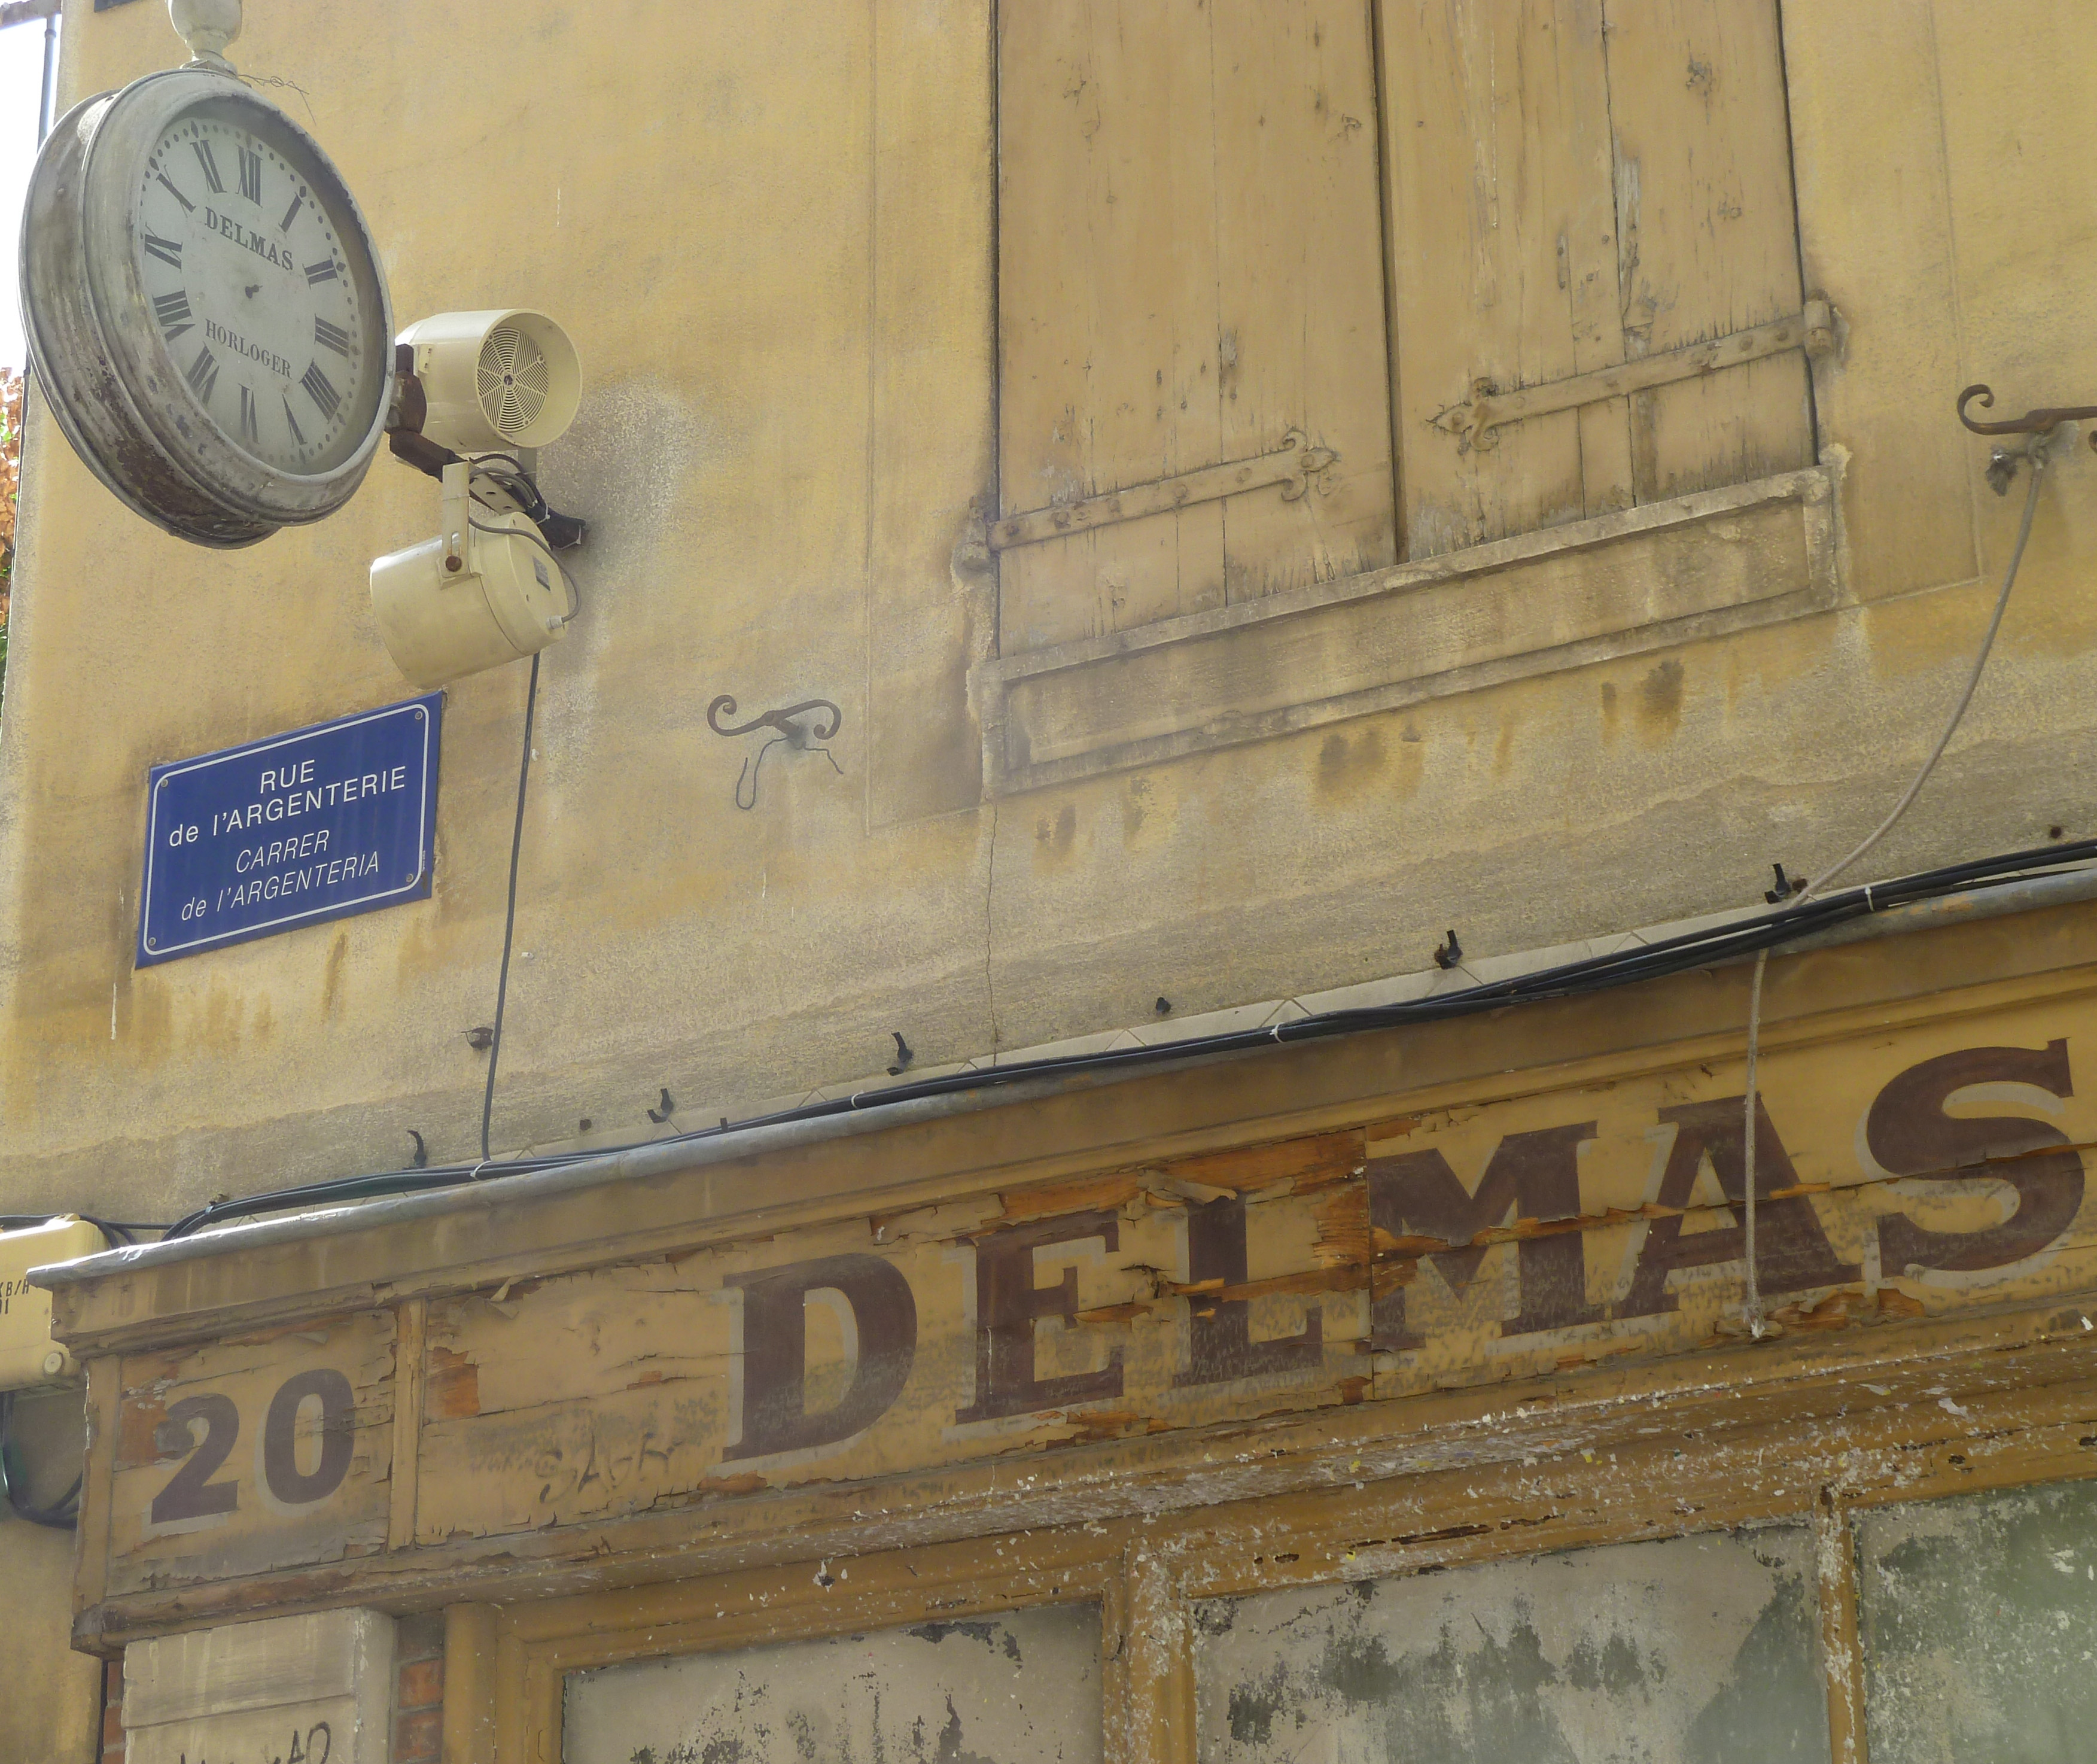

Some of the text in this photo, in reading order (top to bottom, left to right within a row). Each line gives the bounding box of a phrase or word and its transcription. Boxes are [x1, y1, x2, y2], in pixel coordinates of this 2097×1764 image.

[190, 139, 227, 193] XI
[236, 144, 263, 208] XII
[204, 206, 294, 271] DELMAS
[279, 191, 303, 233] I
[303, 256, 339, 291] II
[152, 287, 196, 342] VIII
[314, 314, 349, 358] III
[204, 318, 293, 380] HORLOGER
[282, 392, 308, 447] V
[299, 358, 343, 424] IIII
[260, 759, 316, 794] RUE
[169, 765, 407, 848] de l'ARGENTERIE
[236, 829, 330, 874] CARRER
[181, 850, 381, 921] de l'ARGENTERIA
[722, 1037, 2085, 1464] DELMAS
[151, 1368, 357, 1525] 20
